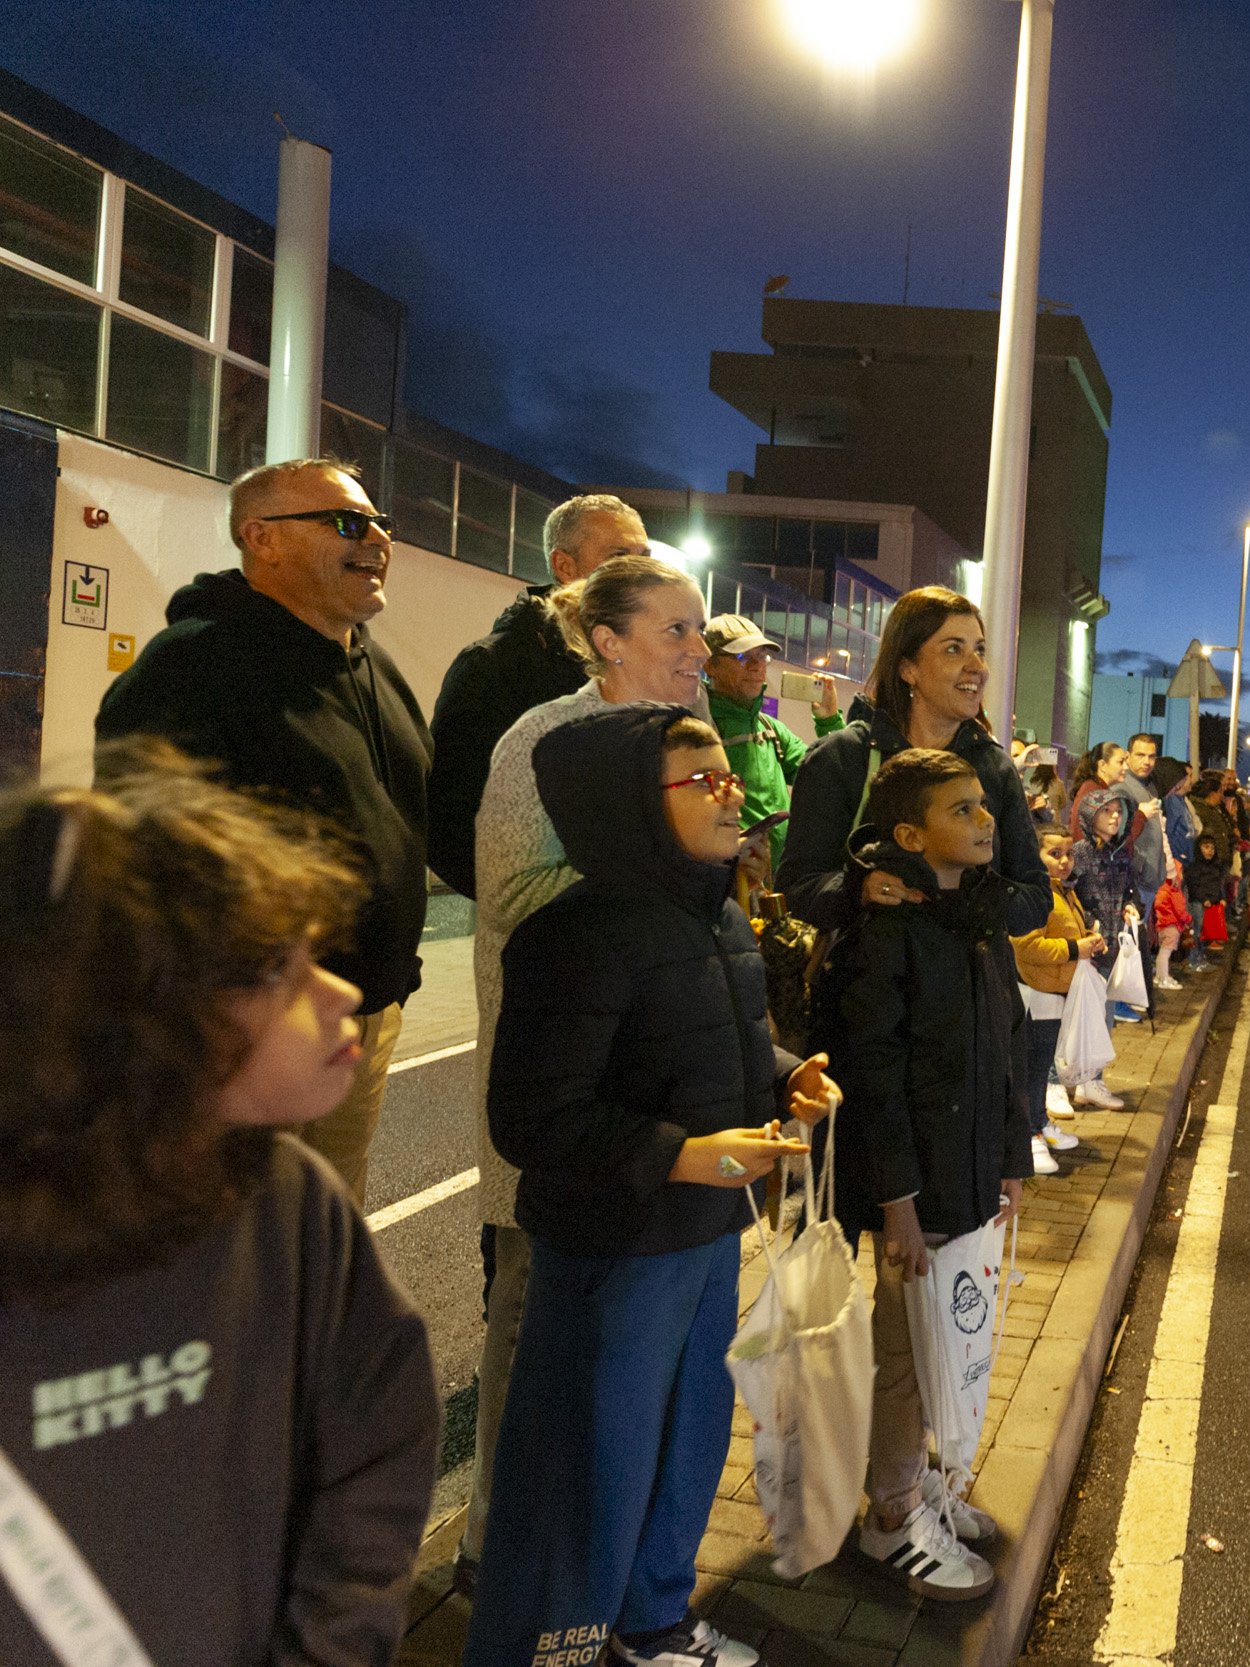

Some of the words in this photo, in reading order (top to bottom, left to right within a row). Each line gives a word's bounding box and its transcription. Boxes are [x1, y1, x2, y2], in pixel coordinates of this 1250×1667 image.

[33, 1340, 212, 1417] HELLO
[34, 1366, 212, 1450] KITTY
[531, 1643, 605, 1667] ENERGY
[537, 1631, 562, 1651] BE
[563, 1623, 609, 1647] REAL
